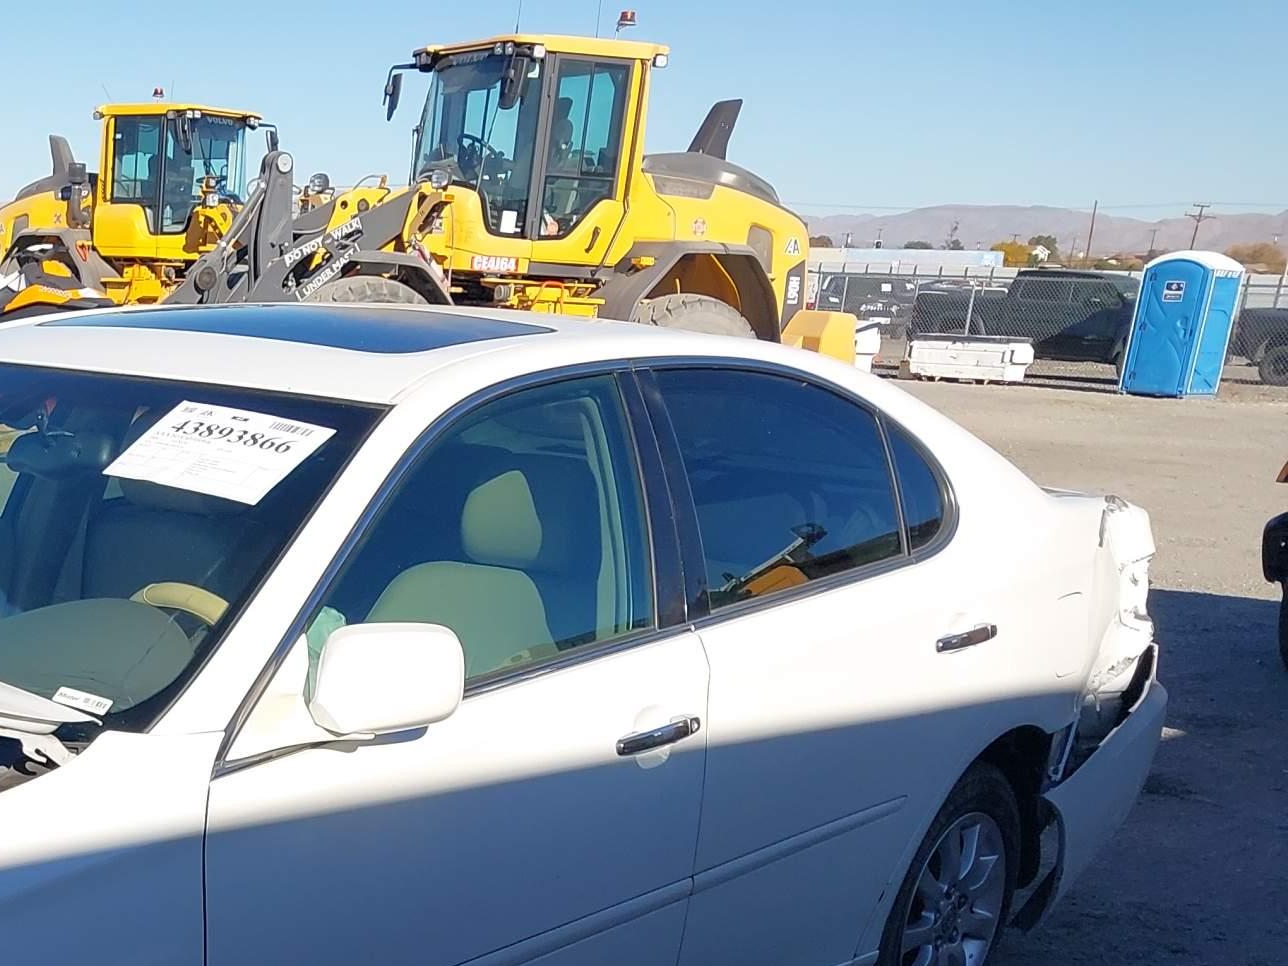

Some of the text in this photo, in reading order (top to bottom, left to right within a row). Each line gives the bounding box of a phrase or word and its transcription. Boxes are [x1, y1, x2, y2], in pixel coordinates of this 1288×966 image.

[207, 116, 233, 126] VOLVO
[285, 218, 359, 267] DO NOT WALK
[302, 247, 355, 294] UNDER MAST
[171, 420, 296, 453] 43893866
